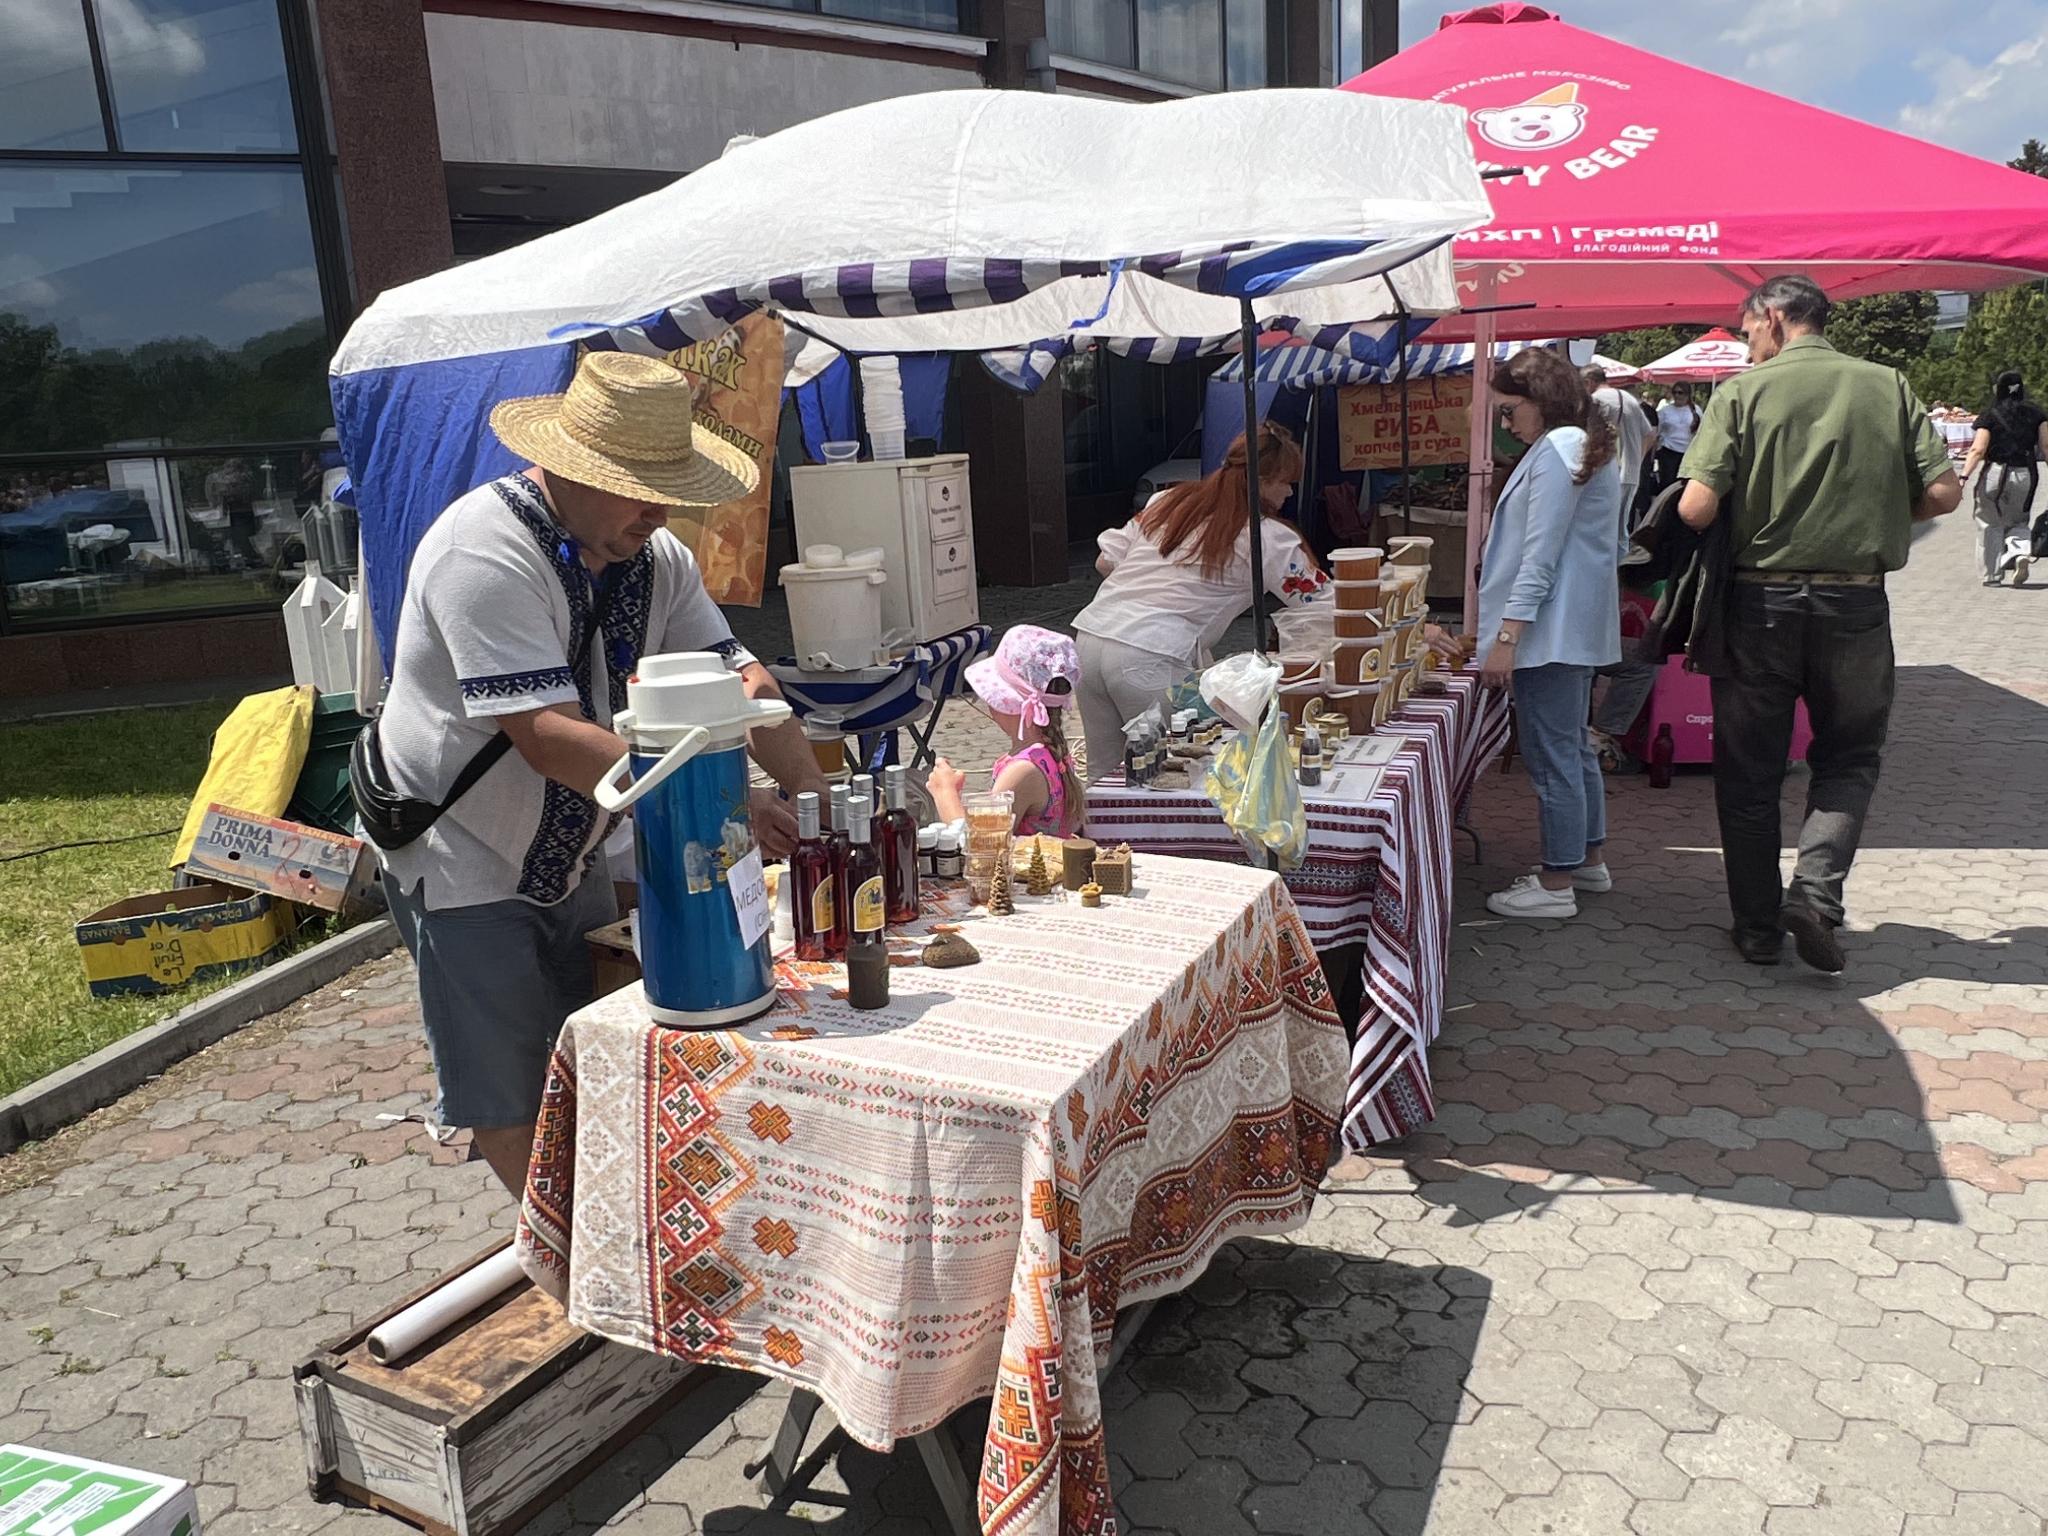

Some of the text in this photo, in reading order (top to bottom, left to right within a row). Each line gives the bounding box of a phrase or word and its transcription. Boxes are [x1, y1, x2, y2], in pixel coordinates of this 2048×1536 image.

[1431, 70, 1632, 101] АТУРАЛЬНЕ МОРОЗИВО
[1564, 124, 1659, 180] BEAR
[1573, 243, 1719, 255] БЛАГОДІЙНИЙ ФОНД
[1374, 414, 1440, 438] РИБА
[1354, 437, 1461, 455] копчеа суха
[214, 816, 273, 844] PRIMA
[297, 826, 351, 846] BANANAS
[208, 831, 271, 858] DONNA
[735, 878, 766, 912] МЕДО
[80, 924, 132, 941] BANANAS
[153, 954, 185, 968] Fruit
[163, 966, 182, 978] Le
